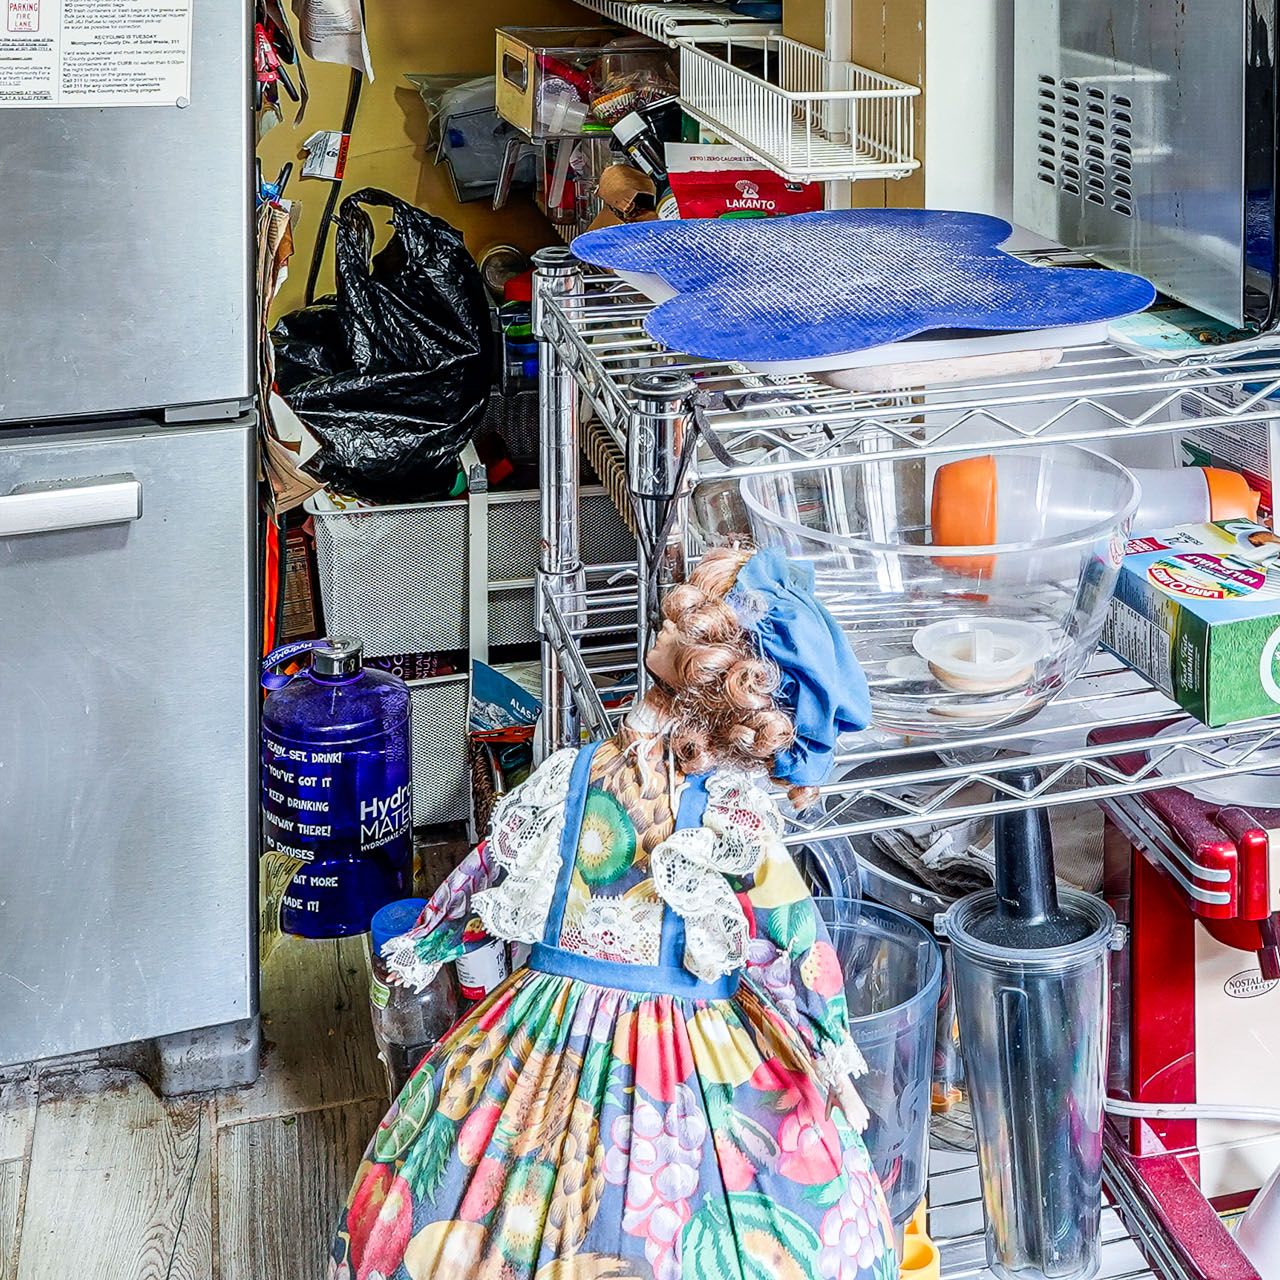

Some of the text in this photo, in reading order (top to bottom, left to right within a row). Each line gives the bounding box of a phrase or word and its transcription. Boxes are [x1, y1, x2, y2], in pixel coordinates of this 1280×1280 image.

[9, 3, 38, 12] PARKING
[725, 199, 776, 210] LAKANTO
[1169, 581, 1219, 598] LAND O
[311, 752, 342, 764] DRINK!
[269, 764, 332, 788] YOU'VE GOT IT
[269, 788, 330, 812] KEEP DRINKING
[267, 812, 332, 837] HALFWAY THERE!
[267, 835, 315, 861] NO EXCUSES
[293, 874, 338, 887] BIT MORE
[307, 900, 319, 912] IT!
[1233, 983, 1272, 994] ELECTRICS
